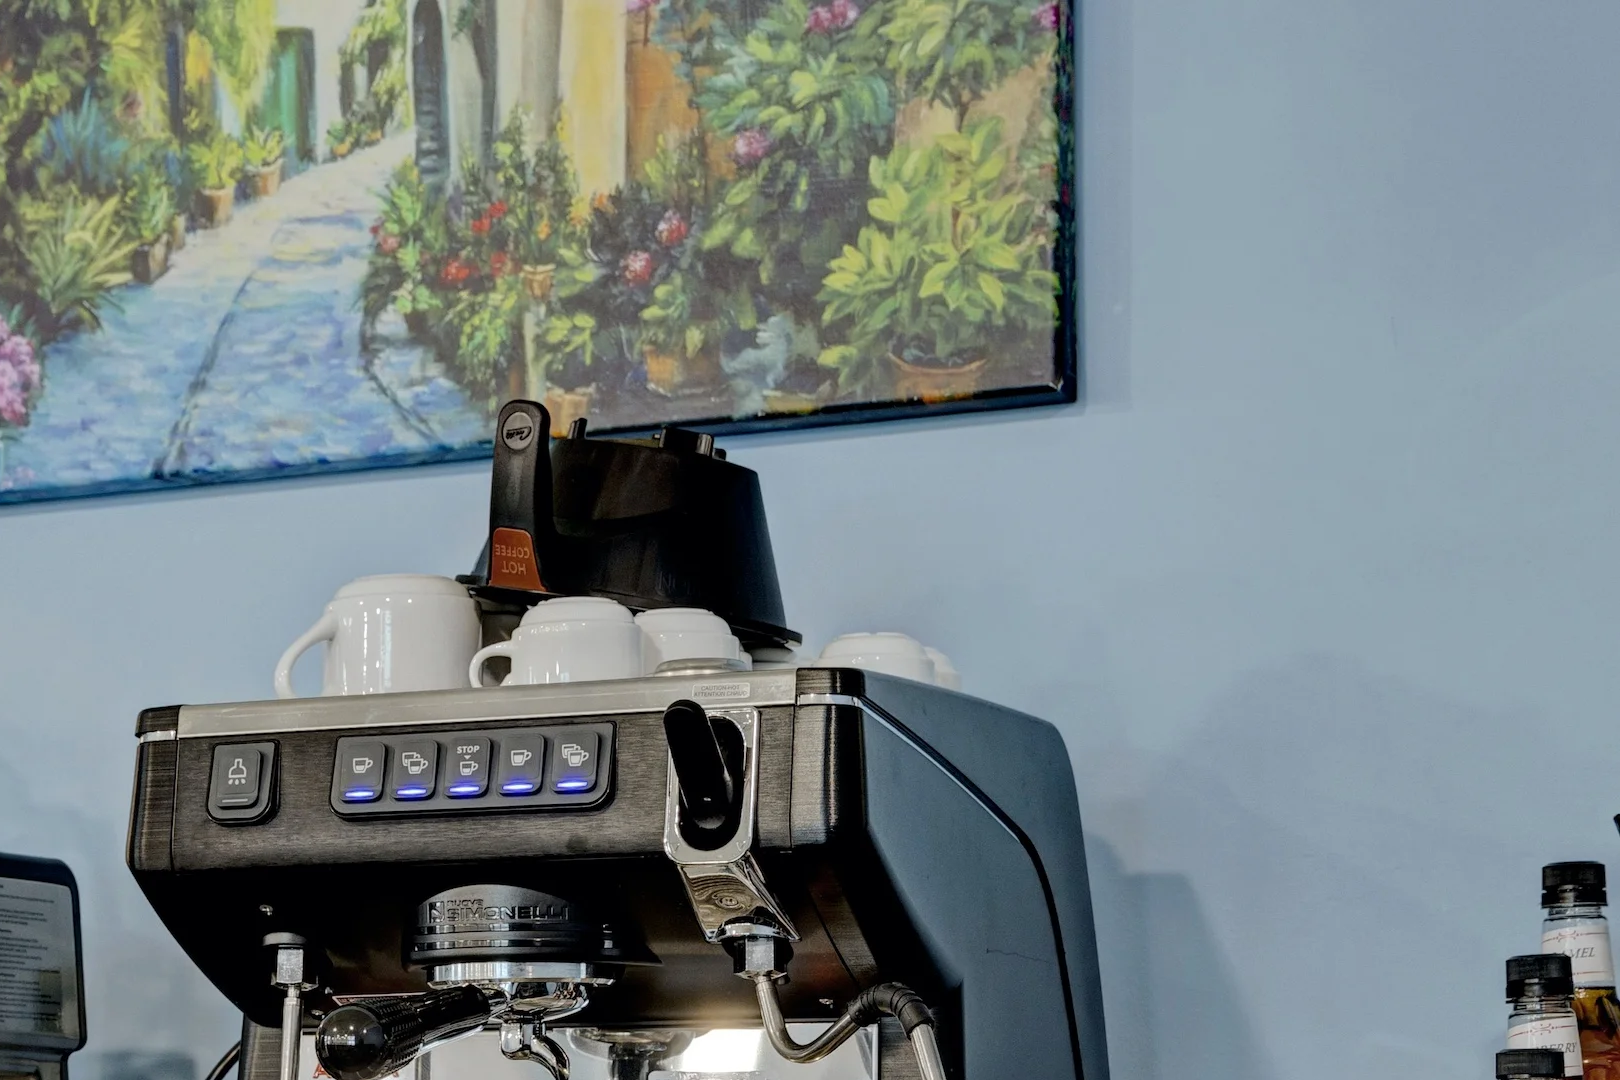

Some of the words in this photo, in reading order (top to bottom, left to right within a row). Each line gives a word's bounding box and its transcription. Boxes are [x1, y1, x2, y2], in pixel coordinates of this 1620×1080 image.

[495, 544, 530, 560] COFFEE
[501, 560, 527, 575] HOT
[456, 745, 480, 754] STOP
[446, 904, 570, 922] SIMONELLI
